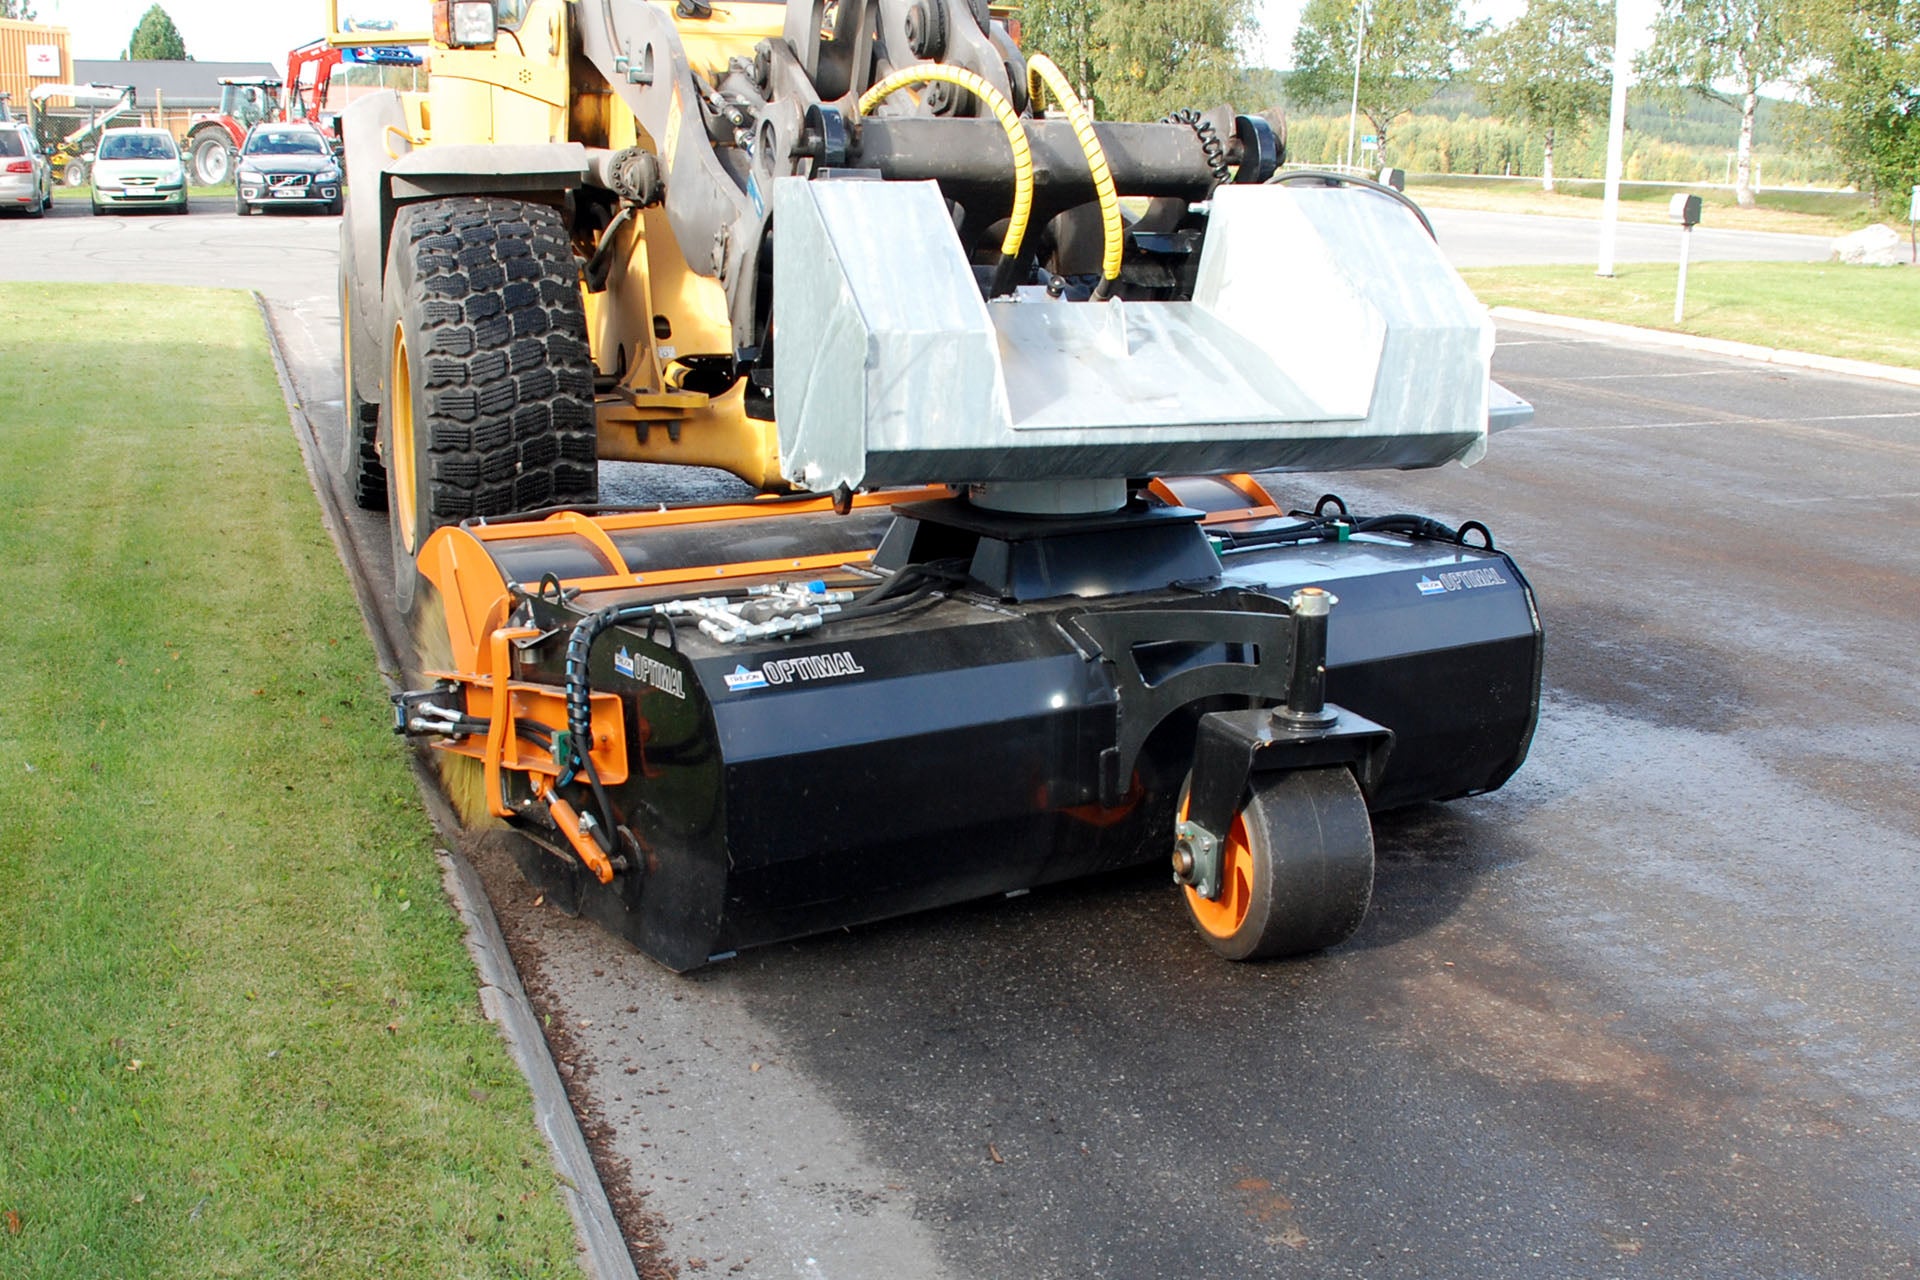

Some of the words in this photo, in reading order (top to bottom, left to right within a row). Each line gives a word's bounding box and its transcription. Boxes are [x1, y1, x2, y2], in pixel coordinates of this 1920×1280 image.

[1439, 568, 1506, 591] OPTIMAL
[634, 652, 686, 699] OPTIMAL
[763, 651, 865, 685] OPTIMAL
